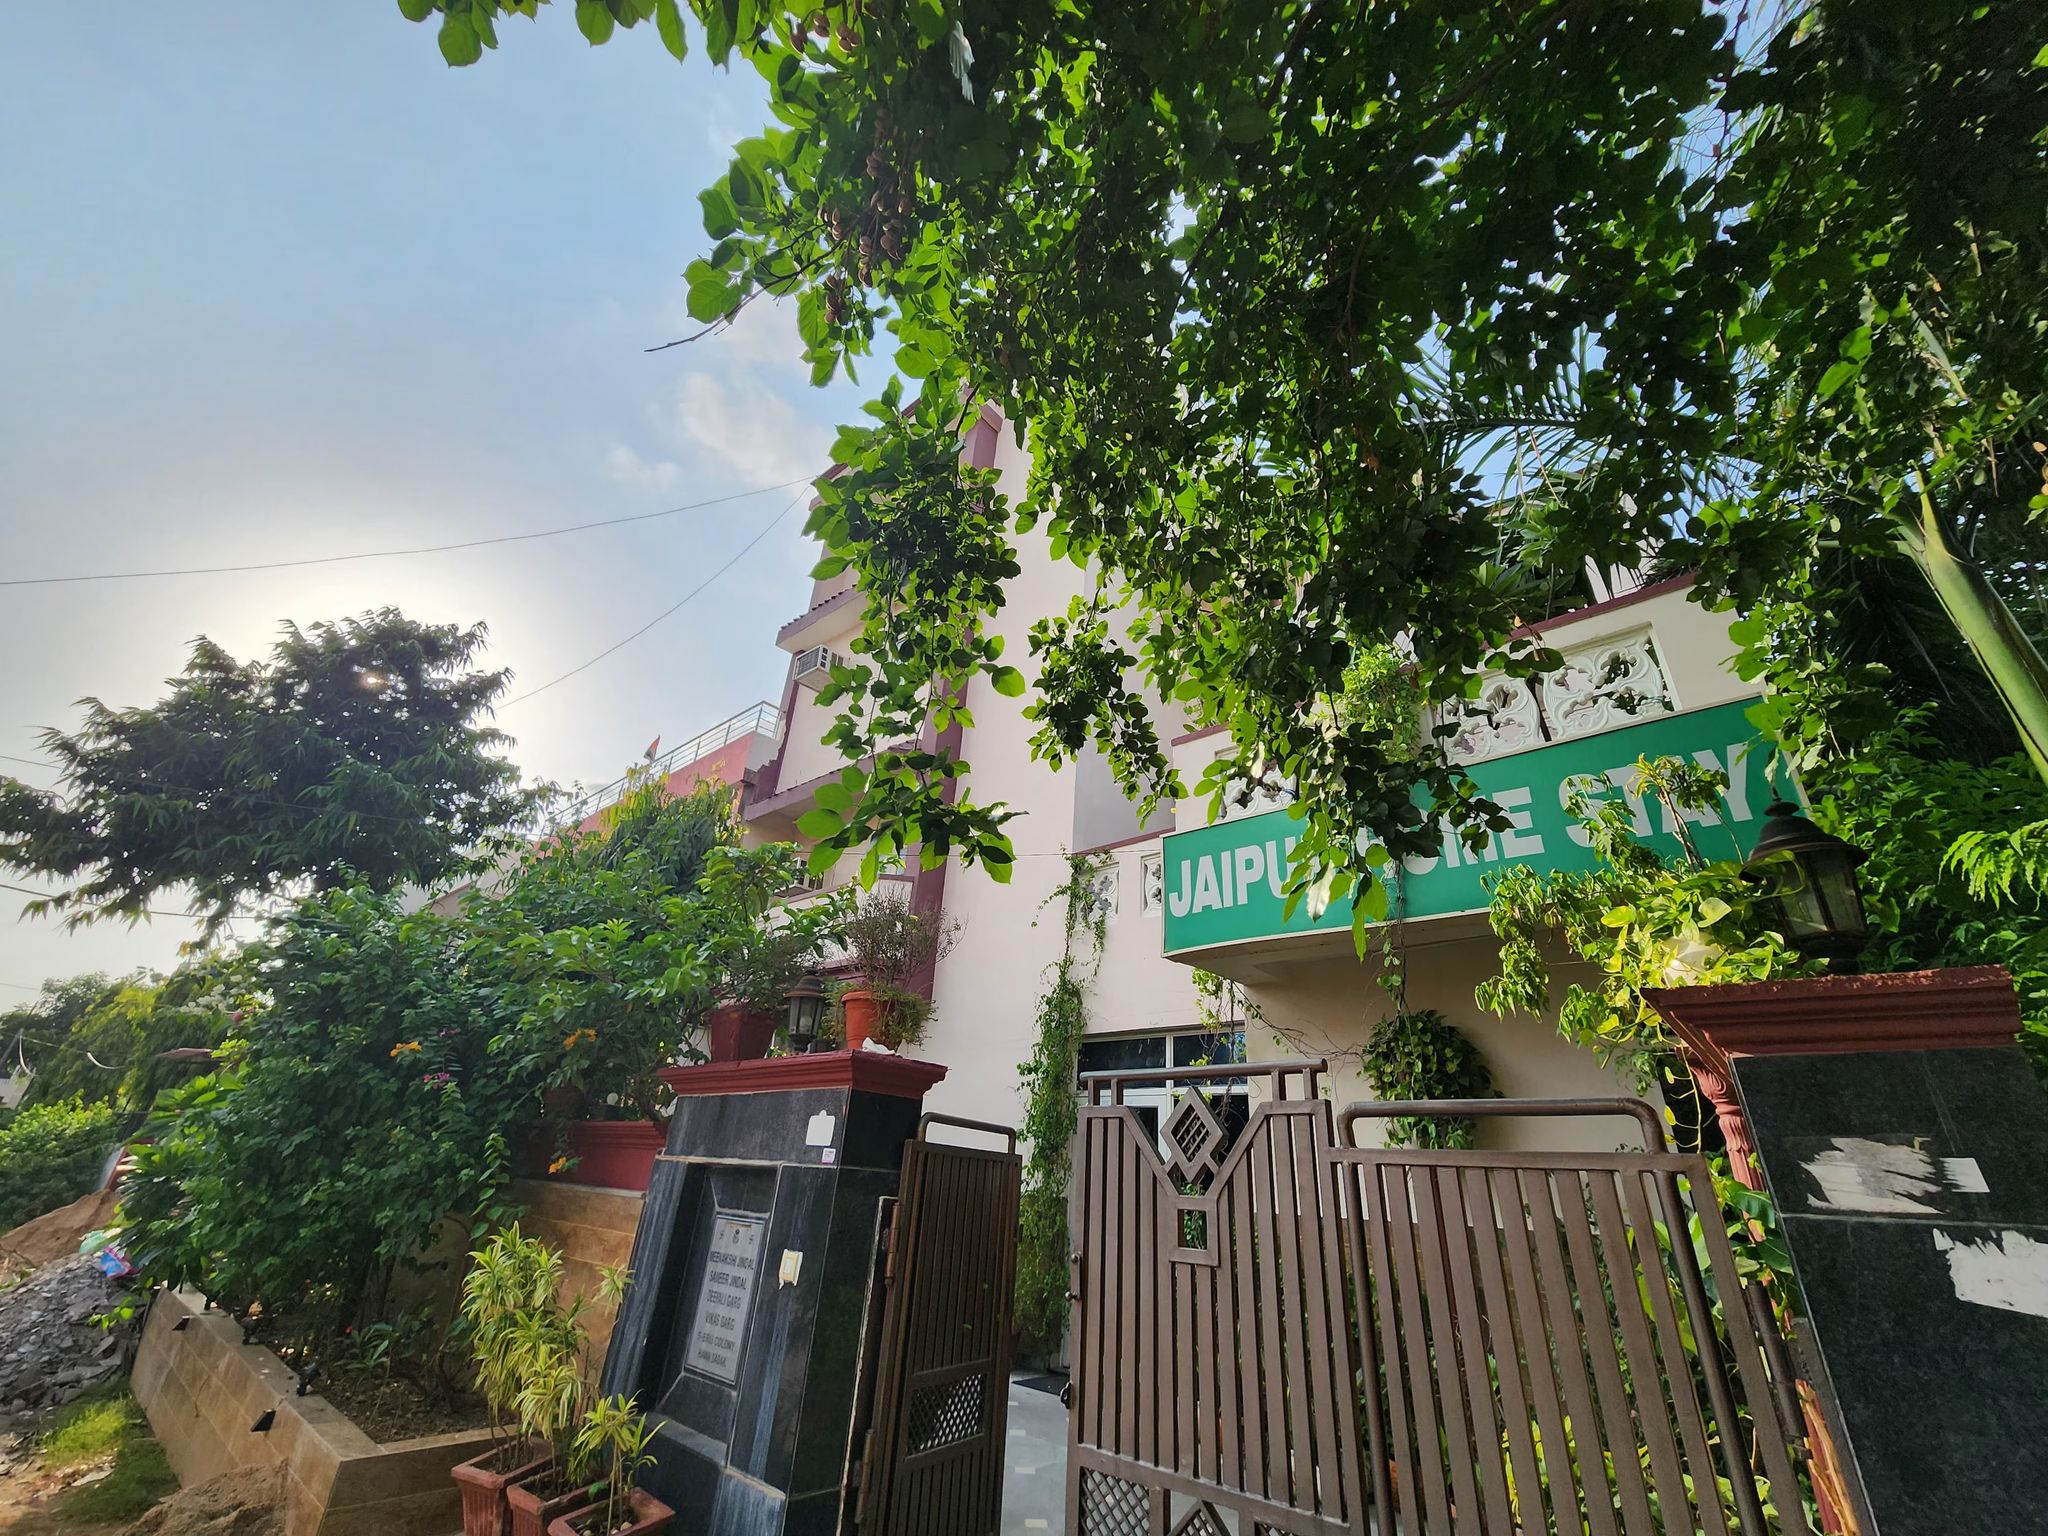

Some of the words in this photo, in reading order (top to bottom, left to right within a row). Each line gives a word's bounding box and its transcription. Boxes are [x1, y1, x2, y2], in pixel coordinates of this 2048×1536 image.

[1169, 836, 1320, 918] JAIPU
[1355, 787, 1545, 879] ME
[1558, 742, 1753, 847] STAY
